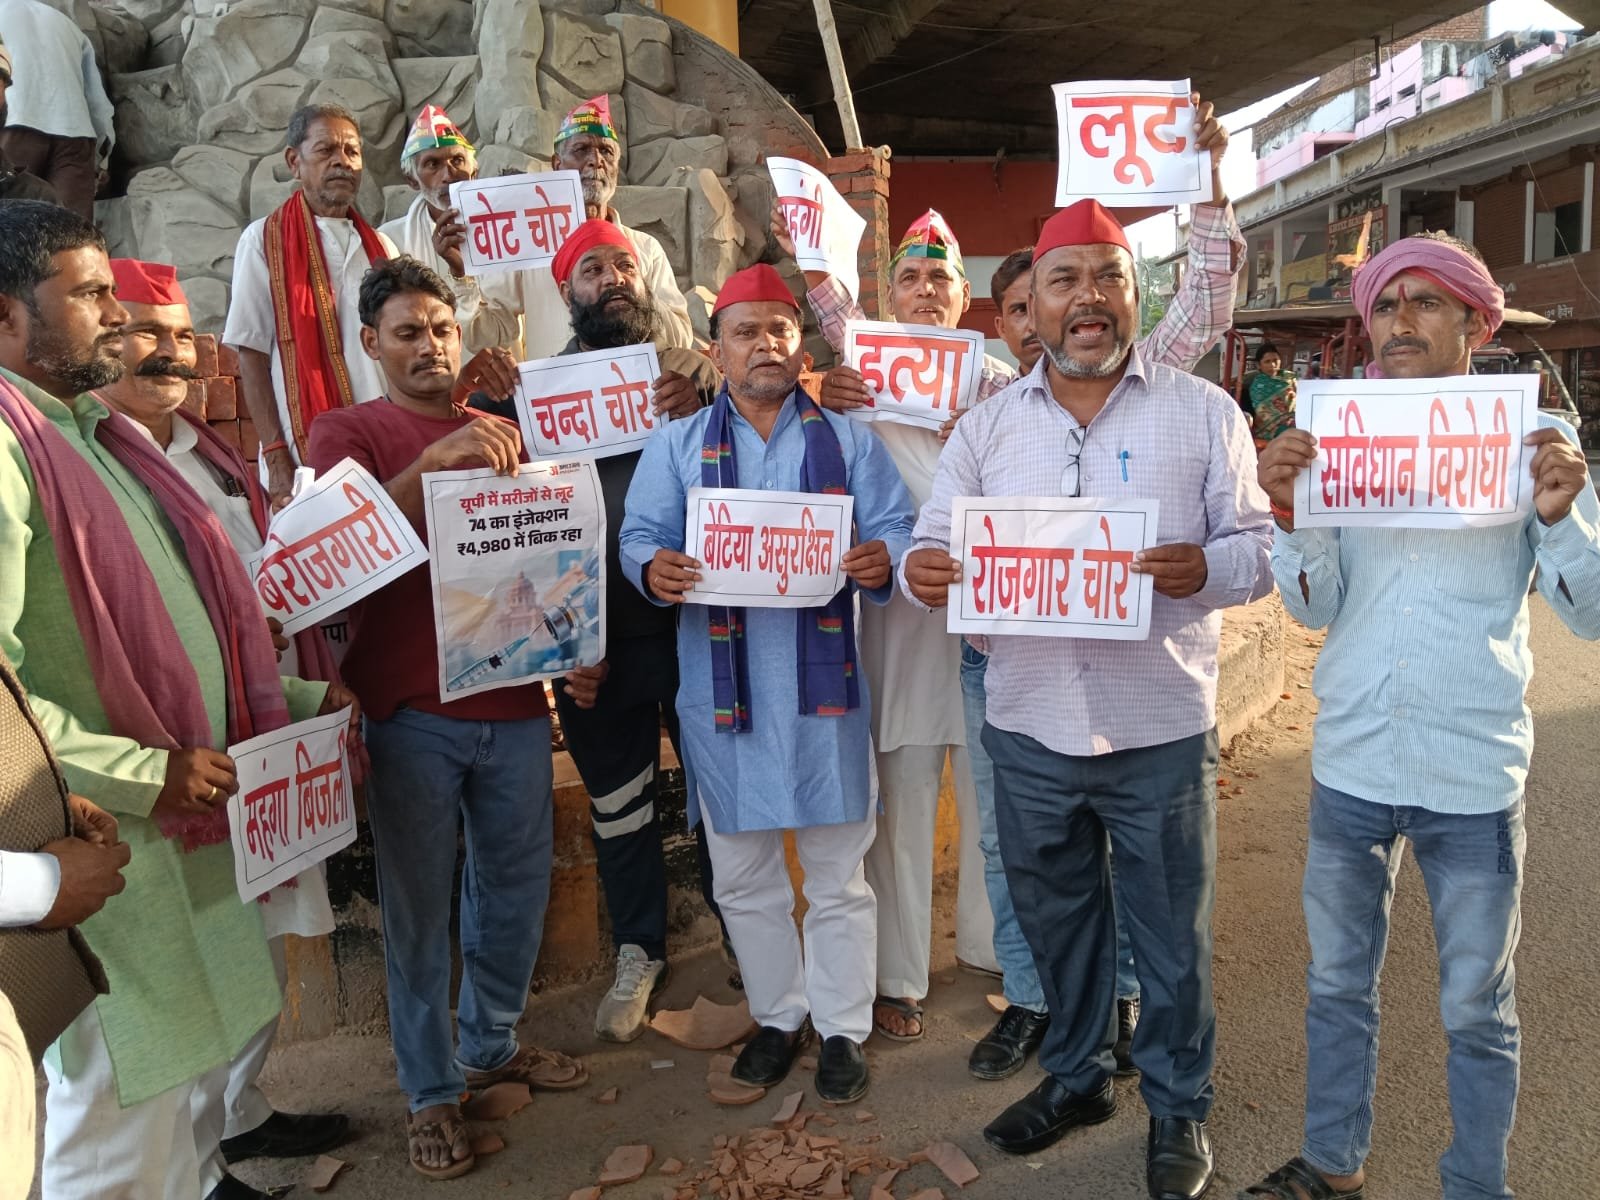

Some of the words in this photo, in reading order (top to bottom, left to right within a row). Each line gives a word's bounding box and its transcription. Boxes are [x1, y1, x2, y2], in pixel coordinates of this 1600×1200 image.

[1071, 96, 1189, 187] लूट
[468, 191, 521, 260] वोट
[524, 185, 572, 253] चोर
[531, 390, 599, 445] चन्दा
[601, 361, 653, 434] चोर
[855, 333, 970, 410] हत्या
[1320, 399, 1420, 508] संविधान
[1427, 396, 1511, 508] विरोधी
[459, 491, 486, 514] यूपी
[487, 490, 499, 507] में
[501, 487, 539, 505] मरीजों
[540, 486, 552, 501] से
[554, 486, 574, 504] लूट
[468, 518, 487, 532] 74
[489, 515, 510, 530] का
[512, 507, 569, 530] इंजेक्शन
[456, 538, 511, 557] ₹4,980
[513, 531, 526, 548] में
[528, 529, 558, 547] बिक
[560, 528, 583, 542] रहा
[703, 501, 754, 572] बेटिया
[758, 506, 834, 596] असुरक्षित
[971, 514, 1075, 617] रोजगार
[1083, 515, 1134, 620] चोर
[244, 757, 290, 862] महंगा
[296, 728, 349, 840] बिजली
